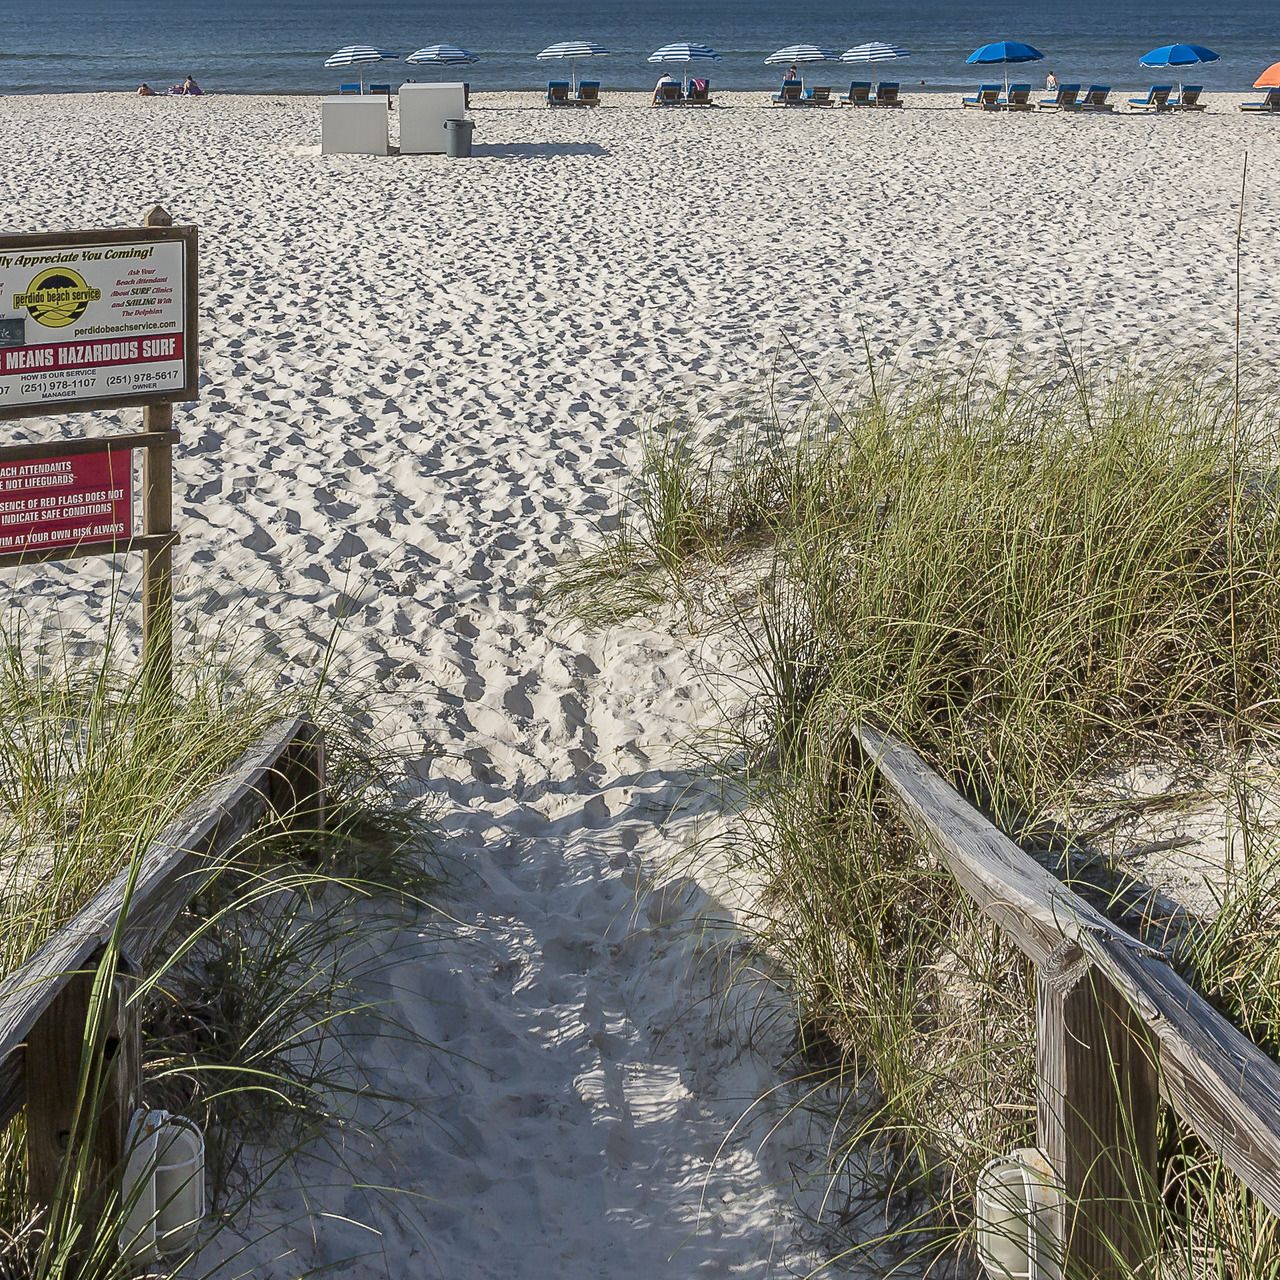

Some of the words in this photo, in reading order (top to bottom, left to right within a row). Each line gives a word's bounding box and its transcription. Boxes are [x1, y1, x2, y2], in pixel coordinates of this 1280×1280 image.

[14, 252, 79, 267] Appreciate
[82, 251, 102, 261] You
[104, 247, 154, 260] Coming!
[136, 277, 168, 285] Attendant
[15, 291, 44, 309] perdido
[47, 289, 69, 304] beach
[72, 287, 100, 300] service
[130, 287, 151, 296] SURF
[125, 298, 156, 307] SAILING
[74, 321, 176, 337] perdidobeachservice.com
[6, 348, 54, 370] MEANS
[58, 340, 138, 365] HAZARDOUS
[142, 338, 175, 357] SURF
[65, 369, 96, 377] SERVICE
[106, 375, 132, 387] (251)
[134, 370, 179, 383] 978-5617
[20, 383, 47, 395] (251)
[49, 378, 96, 391] 978-1107
[42, 390, 76, 399] MANAGER
[19, 461, 72, 475] ATTENDANTS
[6, 479, 22, 490] NOT
[24, 474, 74, 488] LIFEGUARDS
[27, 498, 39, 509] OF
[40, 496, 56, 507] RED
[58, 493, 83, 505] FLAGS
[85, 491, 106, 502] DOES
[107, 489, 124, 500] NOT
[1, 511, 39, 525] INDICATE
[41, 508, 61, 520] SAFE
[63, 503, 112, 518] CONDITIONS
[14, 534, 24, 545] AT
[27, 532, 49, 544] YOUR
[51, 530, 70, 540] OWN
[72, 526, 91, 538] RISK
[93, 523, 124, 536] ALWAYS
